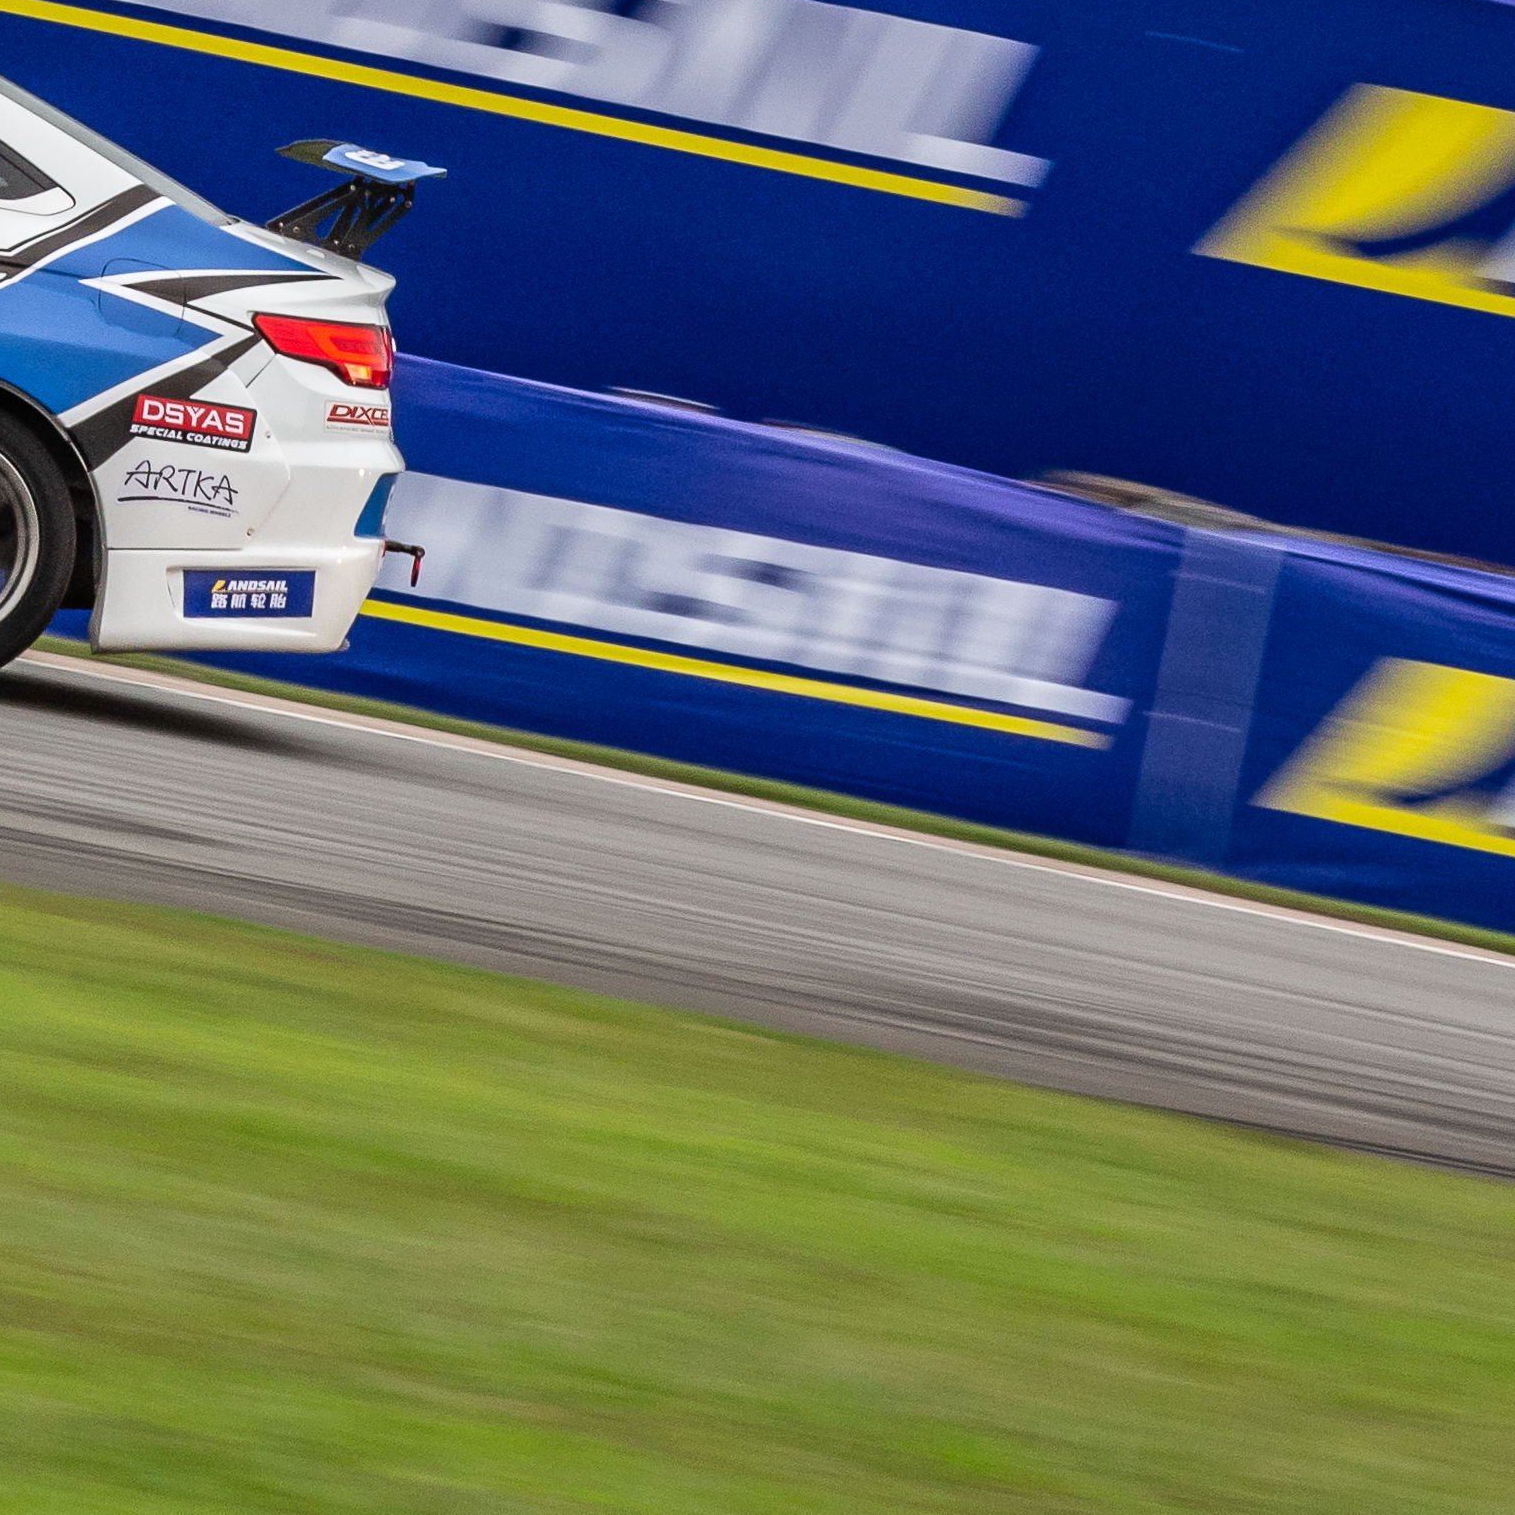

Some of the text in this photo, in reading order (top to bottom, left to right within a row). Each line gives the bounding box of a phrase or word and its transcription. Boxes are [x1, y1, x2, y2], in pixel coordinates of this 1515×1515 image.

[141, 399, 245, 435] DSYAS
[129, 423, 249, 451] SPECIAL COATINGS
[124, 459, 239, 506] ARTKA
